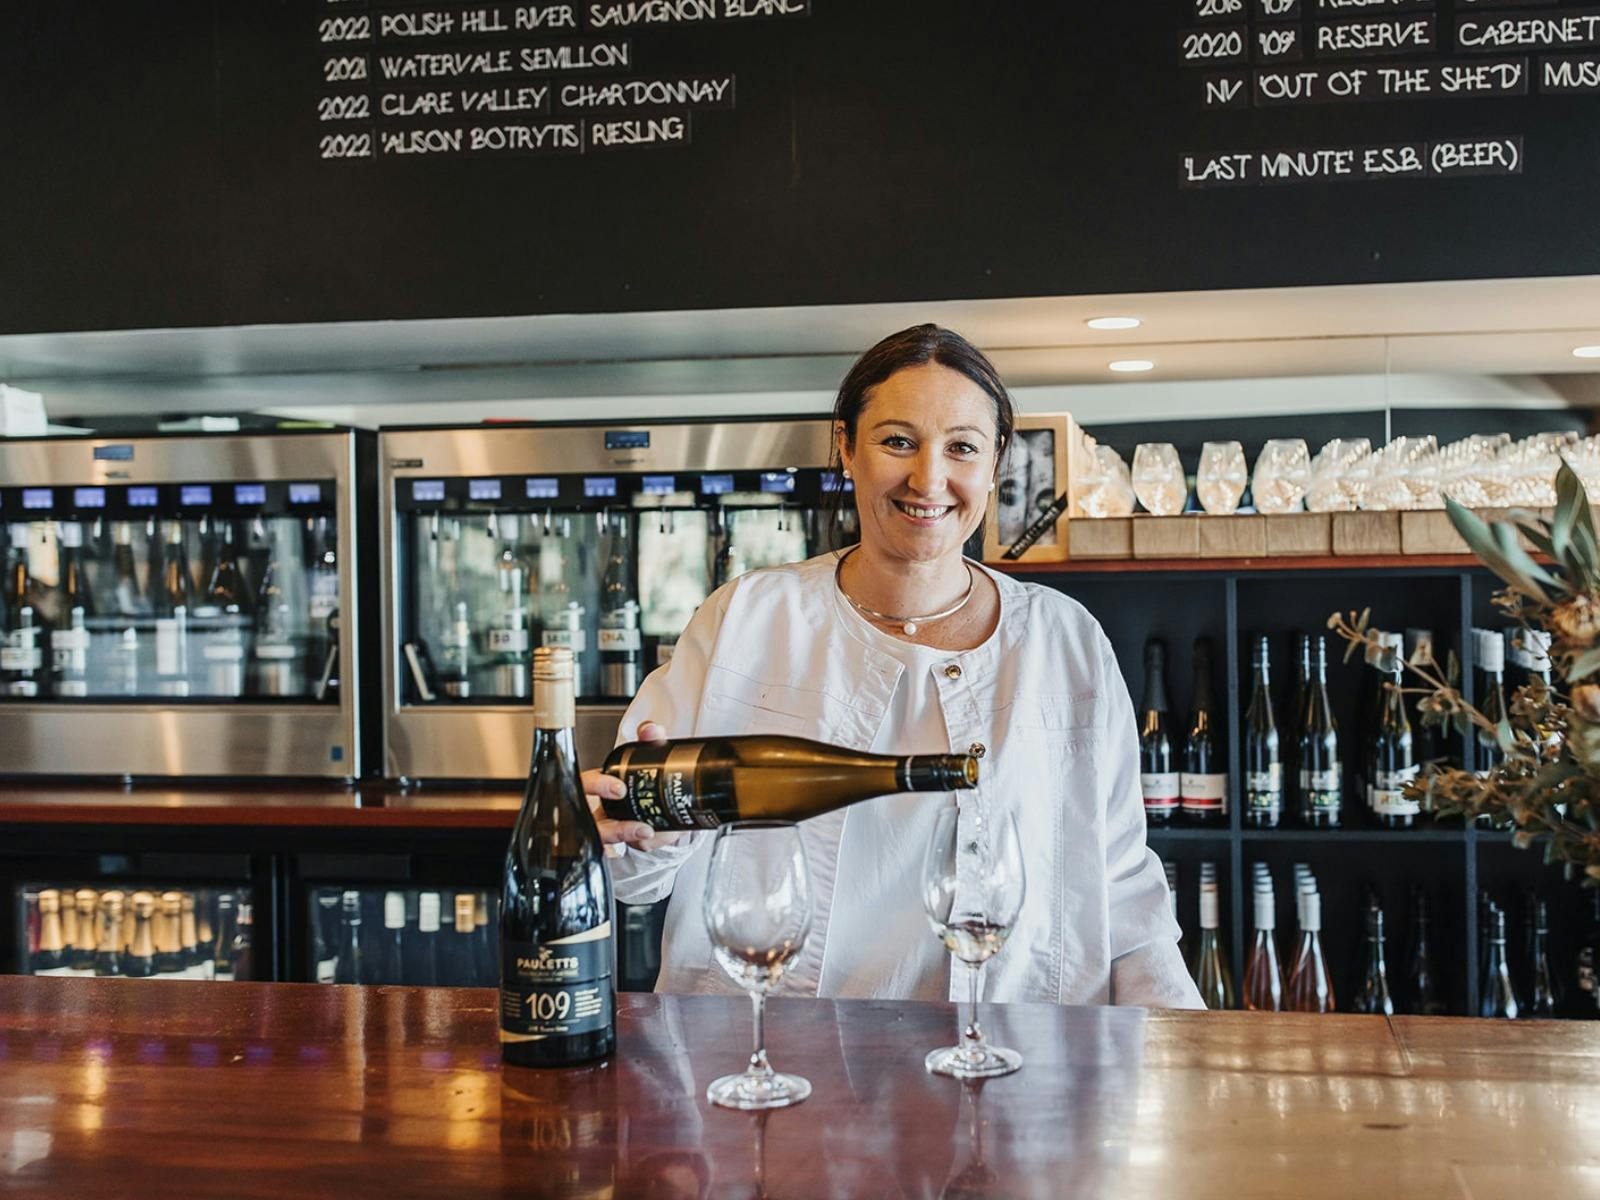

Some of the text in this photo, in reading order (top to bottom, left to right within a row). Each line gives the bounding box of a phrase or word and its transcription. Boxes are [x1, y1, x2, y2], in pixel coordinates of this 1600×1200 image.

[319, 16, 370, 42] 2022
[381, 13, 454, 36] POLISH
[462, 10, 508, 31] HILL
[516, 5, 576, 29] RIVER
[1183, 31, 1242, 59] 2020
[1319, 21, 1430, 50] RESERVE
[1459, 16, 1600, 46] CABERNET
[324, 43, 627, 81] 2021 WATERVALE SEMILLON
[1207, 61, 1600, 103] NV 'OUT OF THE SHED' MUS
[318, 79, 729, 121] 2022 CLARE VALLEY CHARDONNAY
[320, 134, 370, 158] 2022
[470, 124, 579, 149] BOTRYTIS
[592, 117, 684, 145] RIESLING
[1185, 154, 1252, 181] 'LAST
[1261, 150, 1353, 177] MINUTE'
[1432, 140, 1518, 173] (BEER)
[517, 957, 578, 969] PAULETTS
[526, 991, 571, 1019] 109
